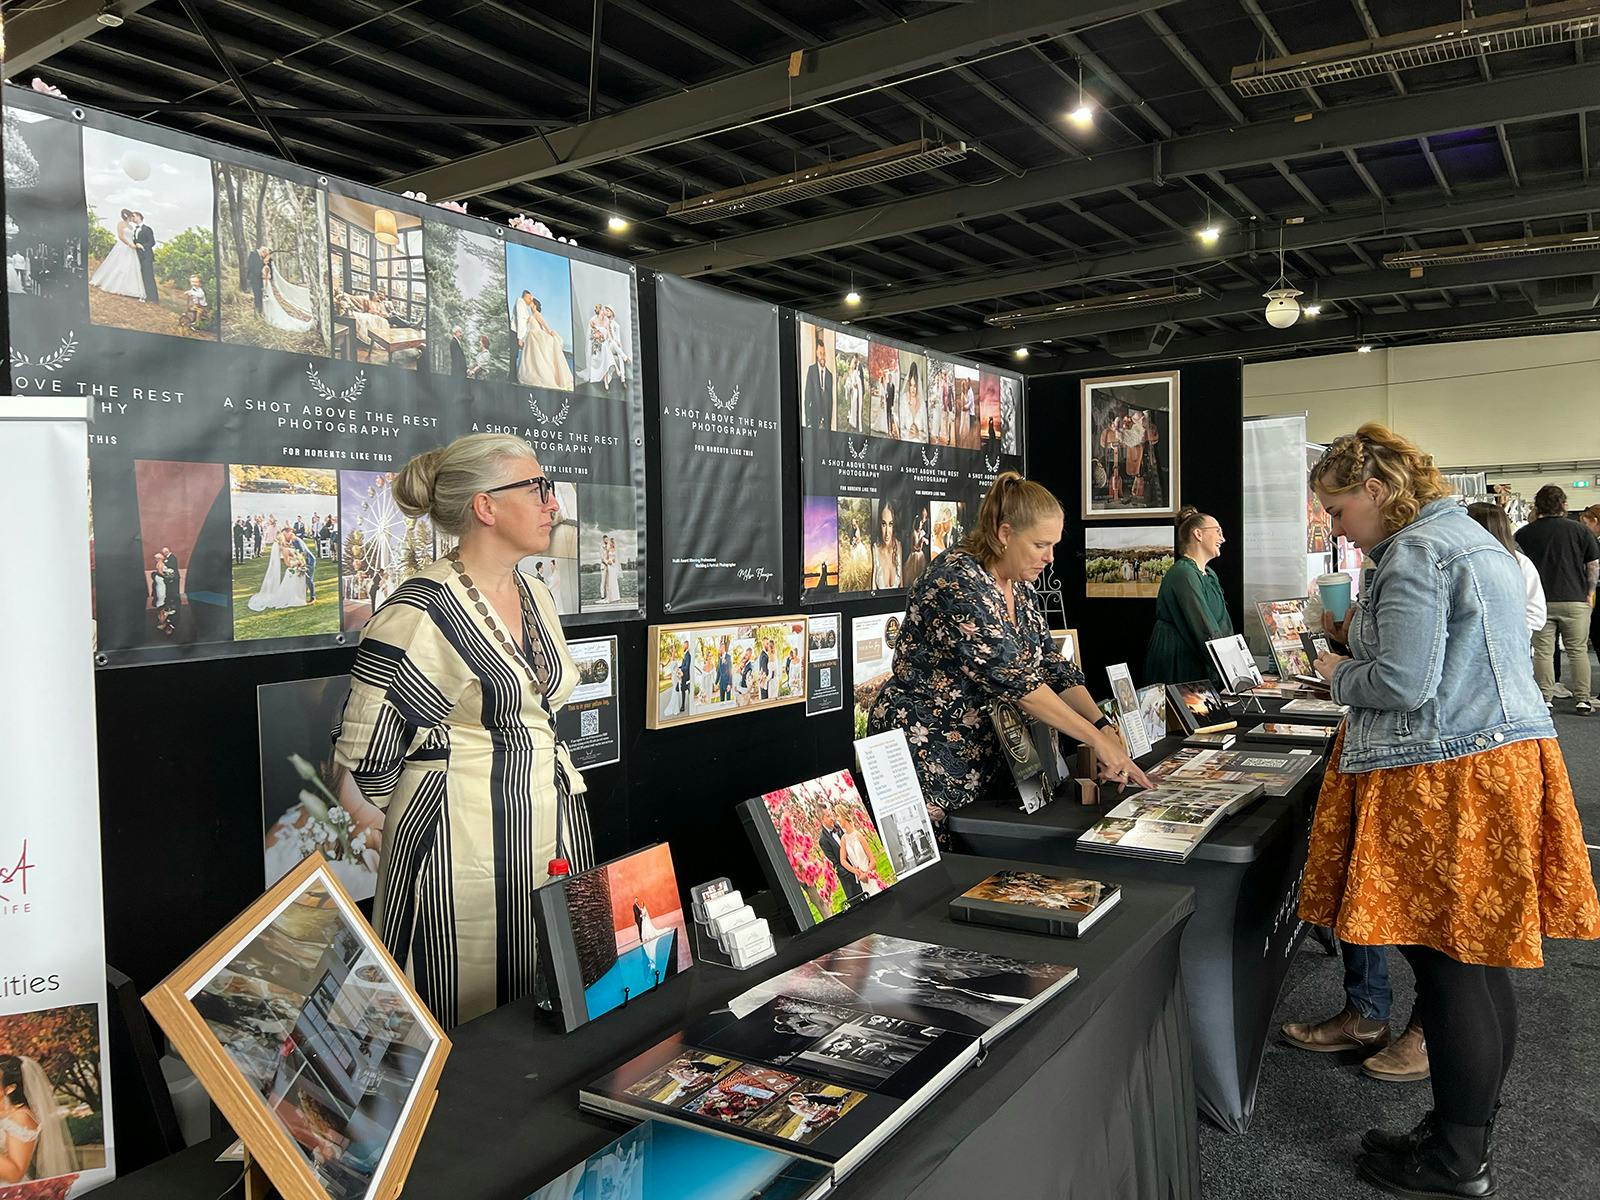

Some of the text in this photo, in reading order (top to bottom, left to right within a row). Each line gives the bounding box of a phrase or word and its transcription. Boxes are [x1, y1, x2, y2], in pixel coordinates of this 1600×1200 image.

[16, 377, 184, 403] OVE THE REST
[224, 397, 438, 427] A SHOT ABOVE THE REST
[664, 406, 777, 430] A SHOT ABOVE THE REST
[278, 417, 400, 437] PHOTOGRAPHY
[692, 421, 757, 437] PHOTOGRAPHY
[88, 434, 117, 445] THIS
[472, 423, 619, 446] A SHOT ABOVE THE REST
[526, 441, 593, 454] OTOGRAPHY
[730, 448, 742, 456] LIKE
[283, 447, 392, 462] FOR MOMENTS LIKE THIS
[558, 466, 572, 474] LIKE
[574, 467, 588, 475] THIS
[828, 459, 844, 467] SHOT
[846, 461, 865, 469] ABOVE
[867, 463, 878, 471] THE
[879, 464, 893, 472] REST
[919, 468, 935, 476] ABOVE
[838, 469, 880, 478] PHOTOGRAPHY
[913, 475, 948, 483] PHOTOGRAPHY
[4, 903, 31, 915] IFE
[0, 974, 60, 998] ities
